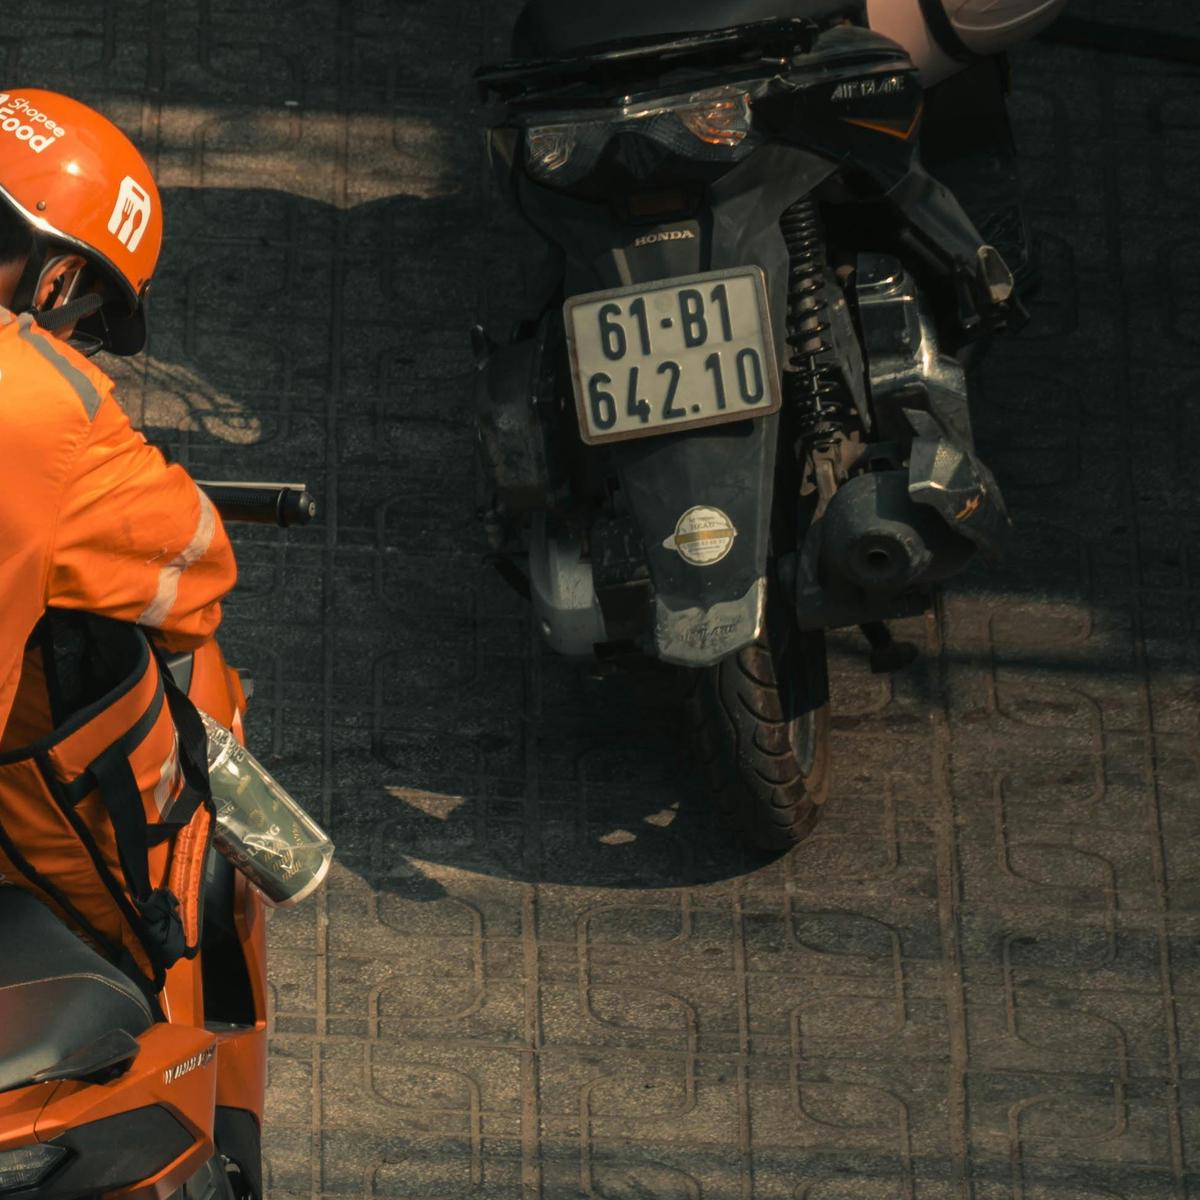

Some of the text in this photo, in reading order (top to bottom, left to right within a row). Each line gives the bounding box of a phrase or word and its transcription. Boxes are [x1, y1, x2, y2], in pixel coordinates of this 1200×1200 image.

[8, 97, 65, 137] Shopee
[634, 229, 695, 247] HONDA
[597, 283, 734, 362] 61-B1
[587, 347, 765, 431] 642.10
